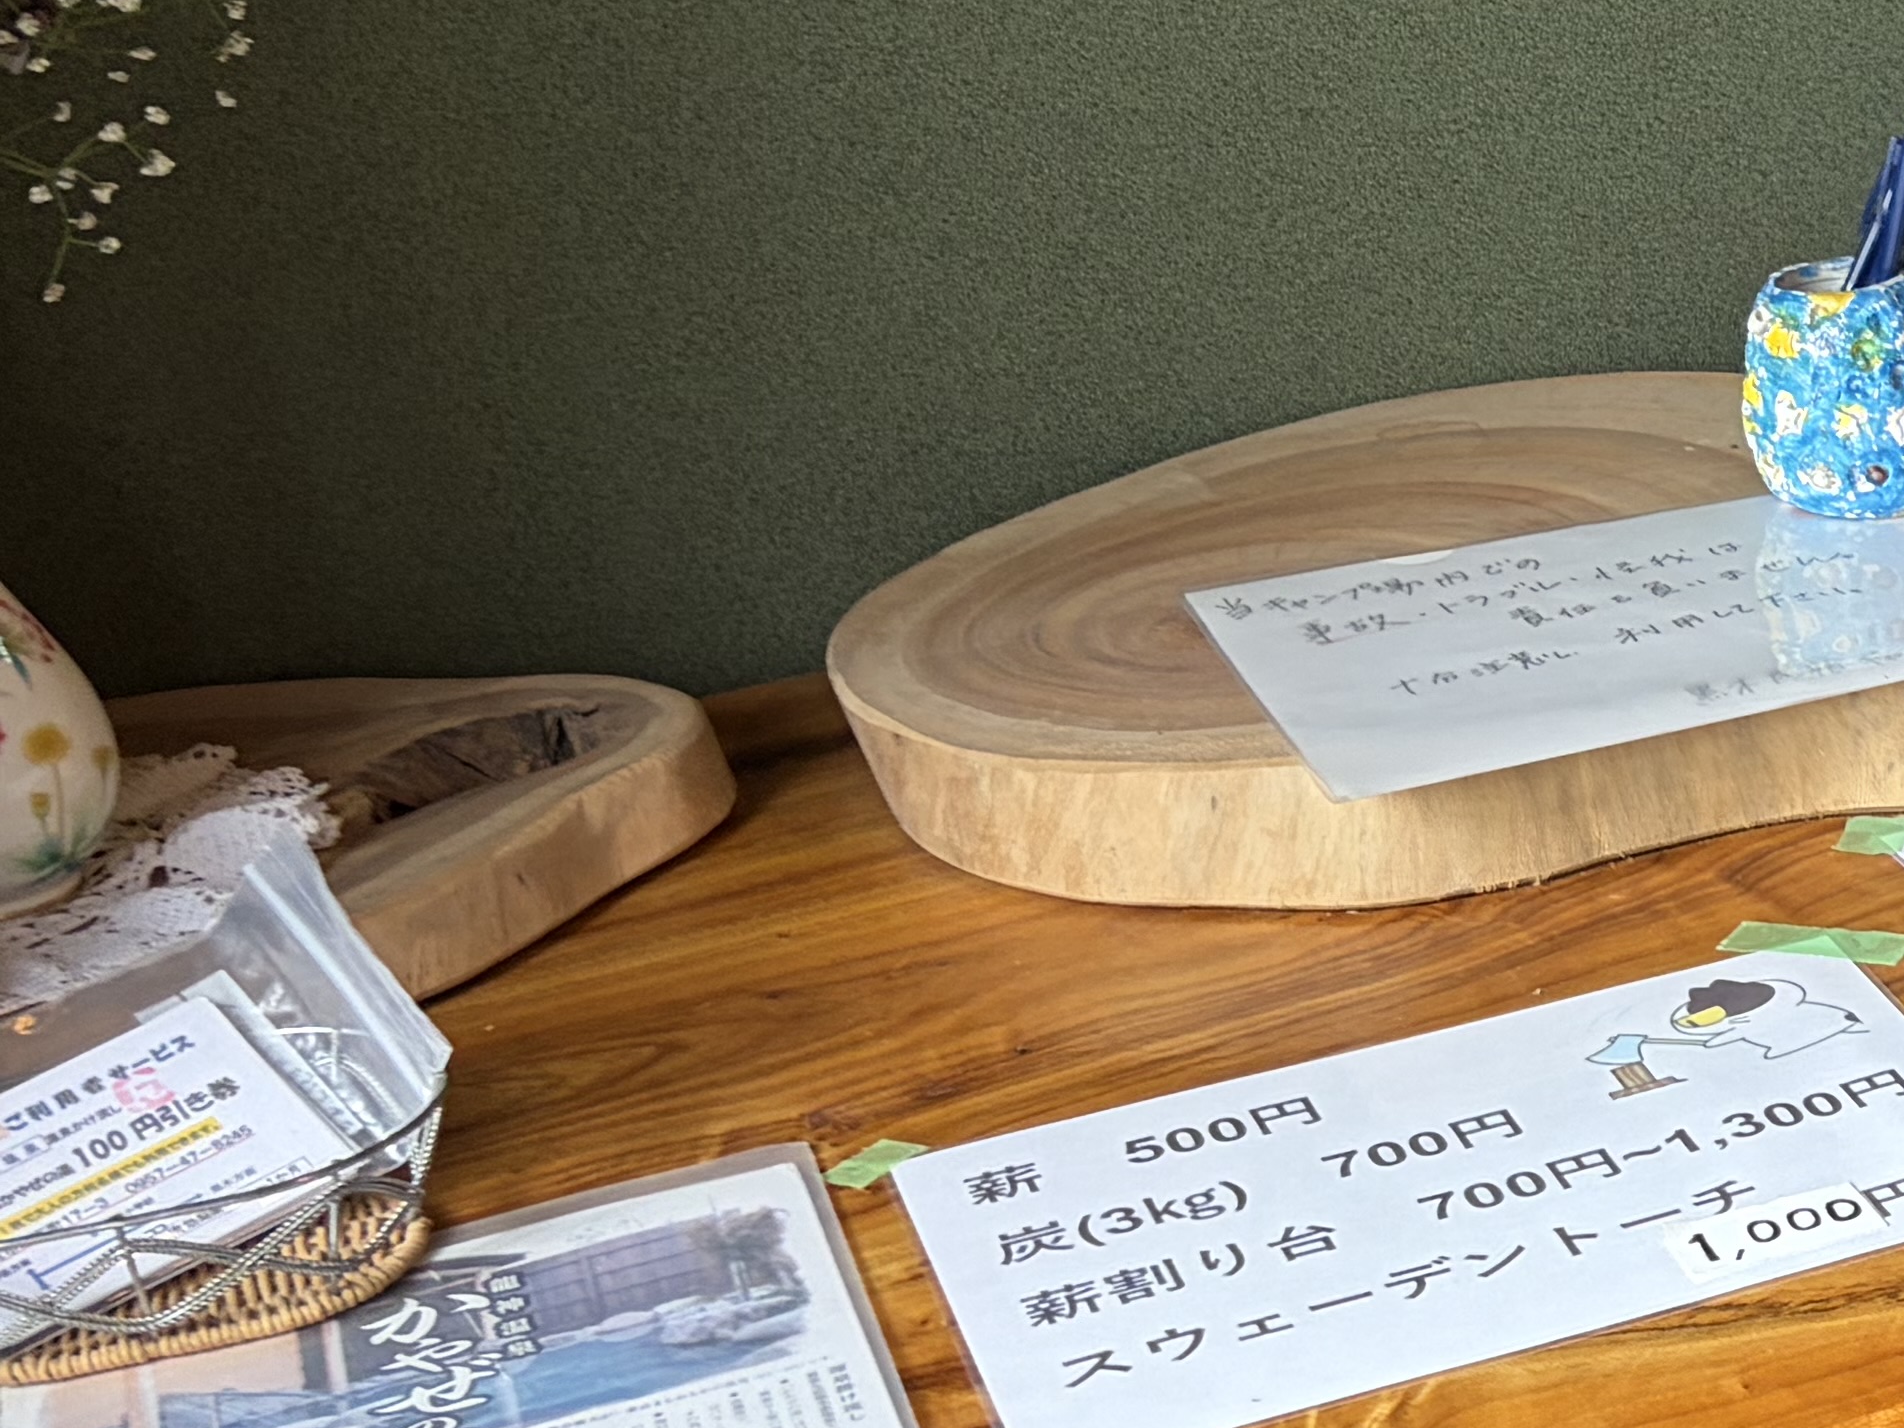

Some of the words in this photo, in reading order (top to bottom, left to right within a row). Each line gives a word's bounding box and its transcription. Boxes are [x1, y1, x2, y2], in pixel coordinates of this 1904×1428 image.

[965, 1161, 1041, 1208] 薪
[1123, 1094, 1323, 1168] 500円
[997, 1179, 1251, 1267] 炭(3kg)
[1319, 1107, 1525, 1180] 700円
[1021, 1218, 1340, 1332] 薪割り台
[1061, 1176, 1760, 1389] スウェーデントーチ
